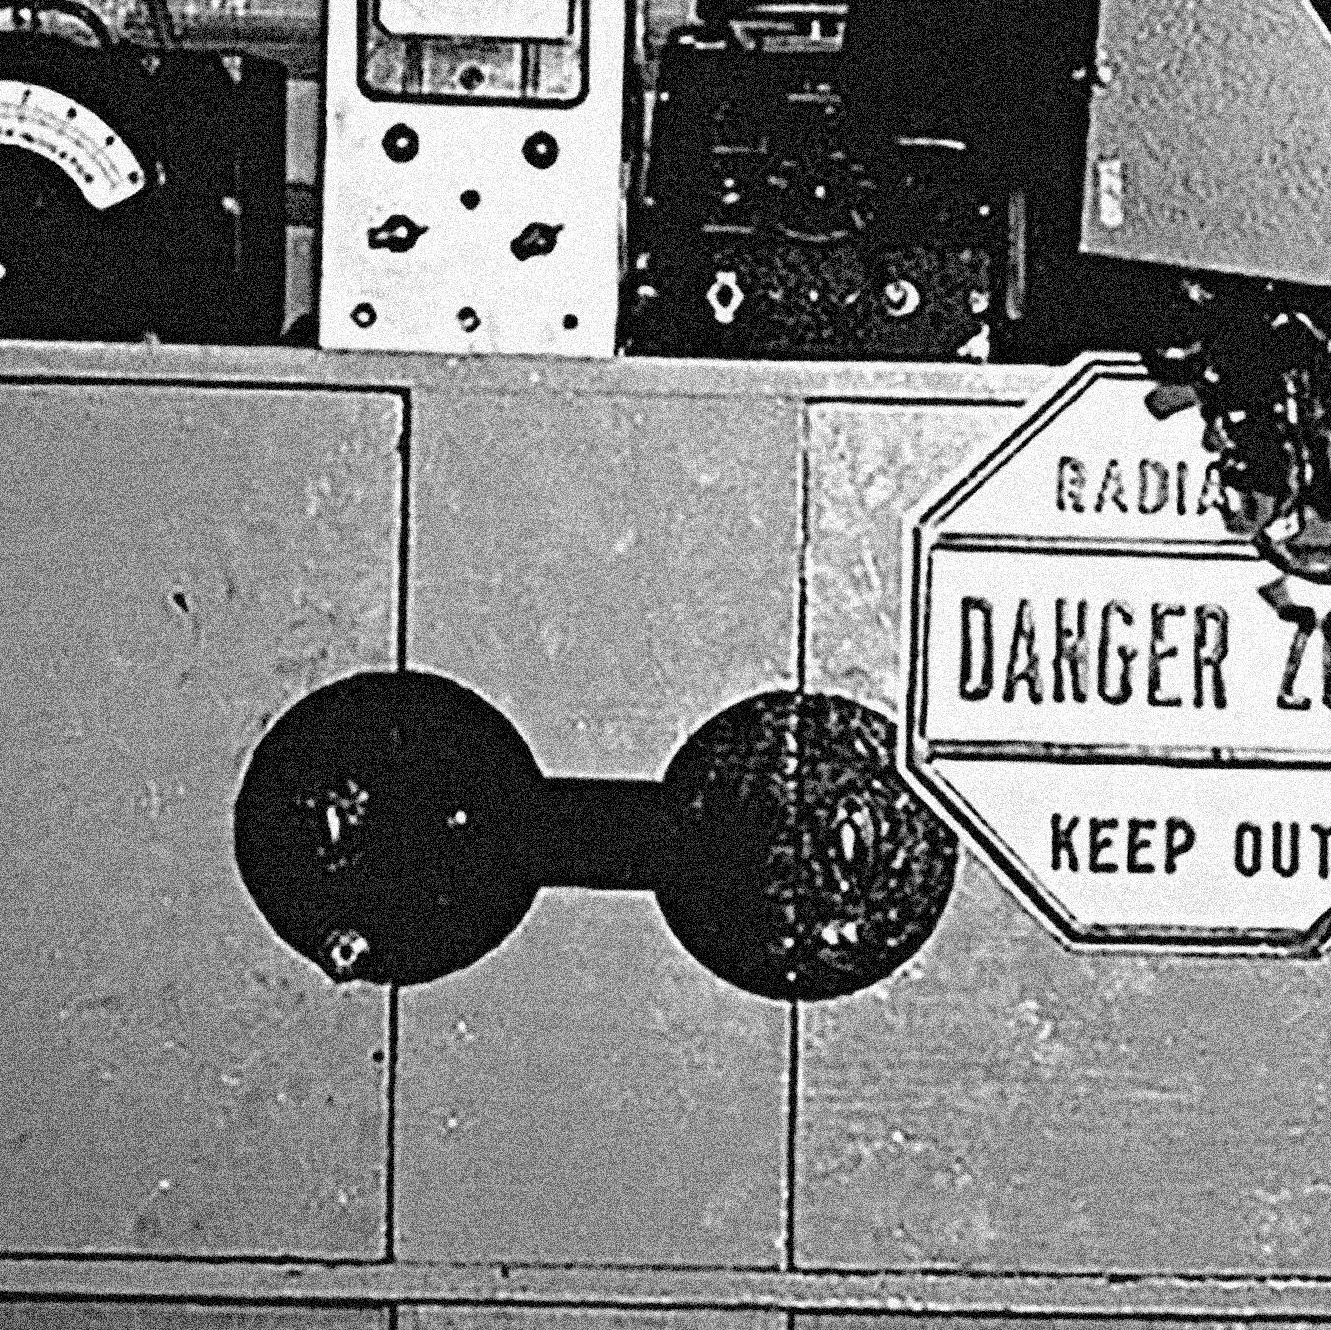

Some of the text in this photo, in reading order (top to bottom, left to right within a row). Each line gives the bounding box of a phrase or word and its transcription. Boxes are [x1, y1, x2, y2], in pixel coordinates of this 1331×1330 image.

[1056, 455, 1225, 516] RADIA
[960, 596, 1228, 710] DANGER
[1051, 813, 1195, 875] KEEP
